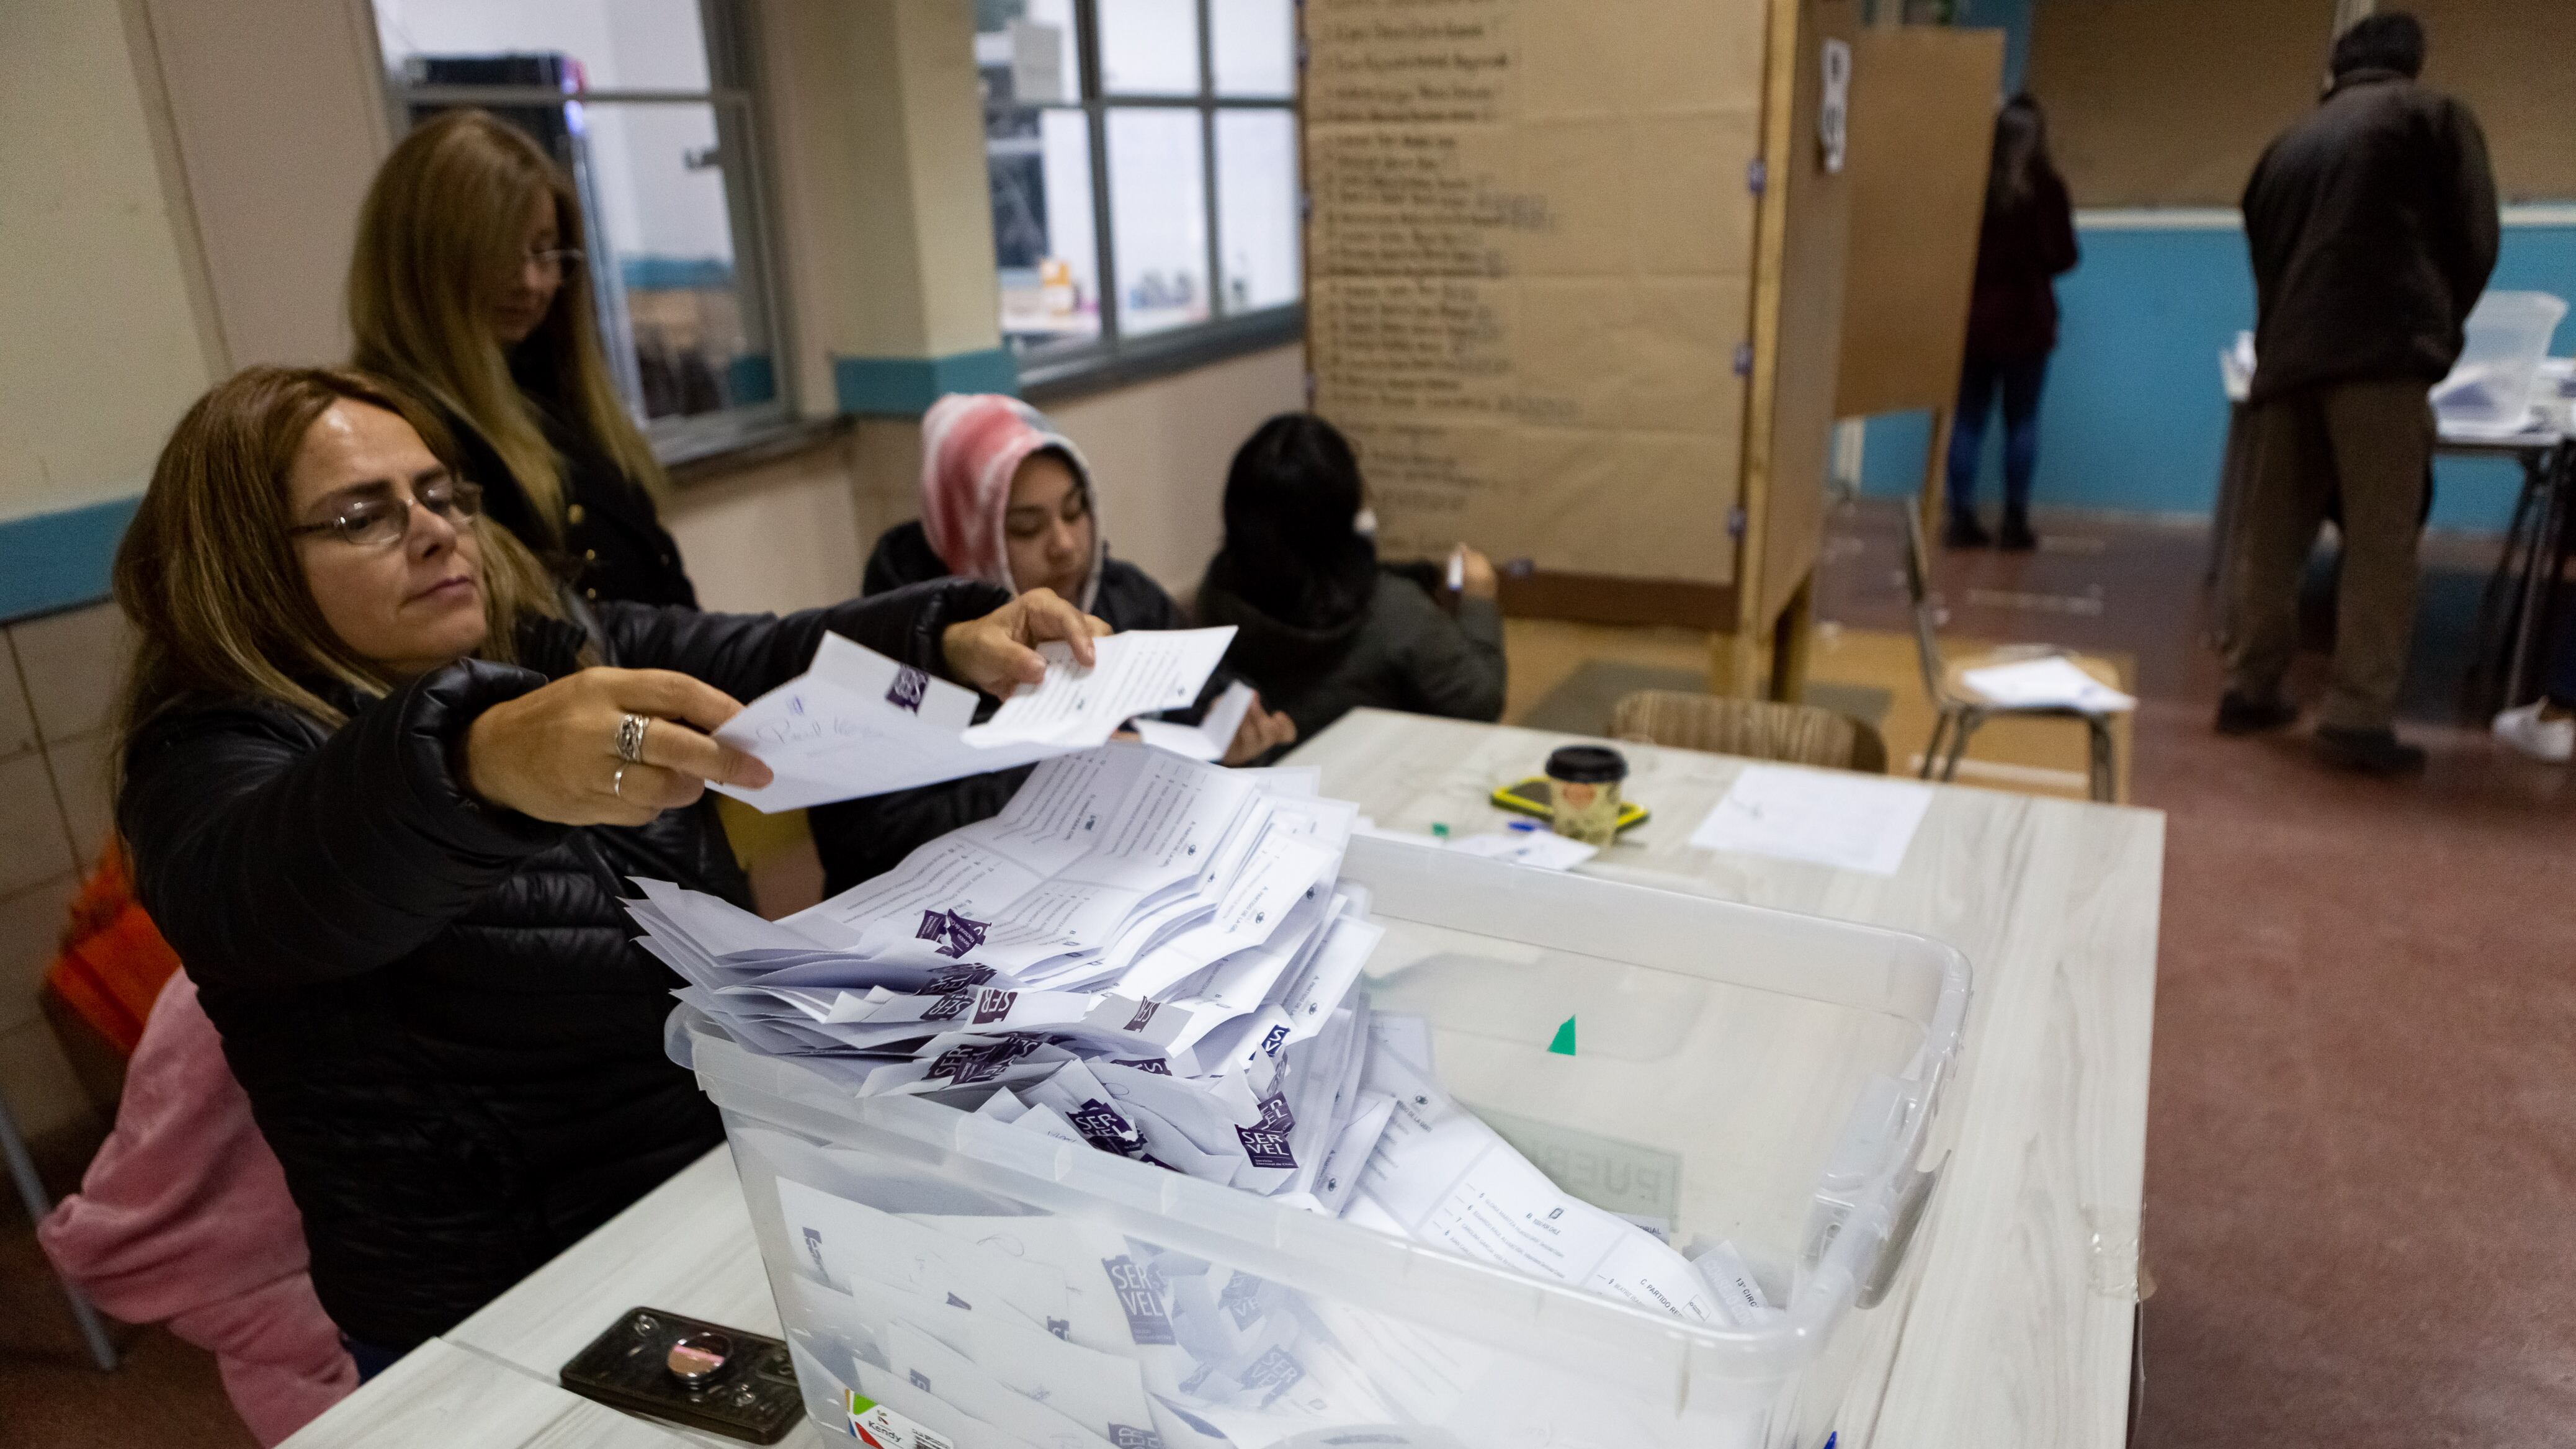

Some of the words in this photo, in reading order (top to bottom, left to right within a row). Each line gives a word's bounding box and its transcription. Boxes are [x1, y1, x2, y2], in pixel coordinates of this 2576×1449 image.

[958, 925, 975, 944] Electoral
[1299, 980, 1316, 1003] PARTIDO
[1294, 1001, 1302, 1010] DE
[934, 1048, 973, 1076] SER
[1075, 1113, 1117, 1130] SER
[1241, 1131, 1283, 1144] SER
[1246, 1144, 1289, 1155] VEL
[1111, 1264, 1152, 1290] SER
[1607, 1276, 1616, 1285] 9
[1118, 1290, 1163, 1317] VEL
[1234, 1297, 1259, 1317] VE
[1645, 1283, 1672, 1309] PARTIDO
[1742, 1288, 1760, 1310] CIRC
[1260, 1347, 1300, 1386] SER
[869, 1420, 902, 1443] Kendy
